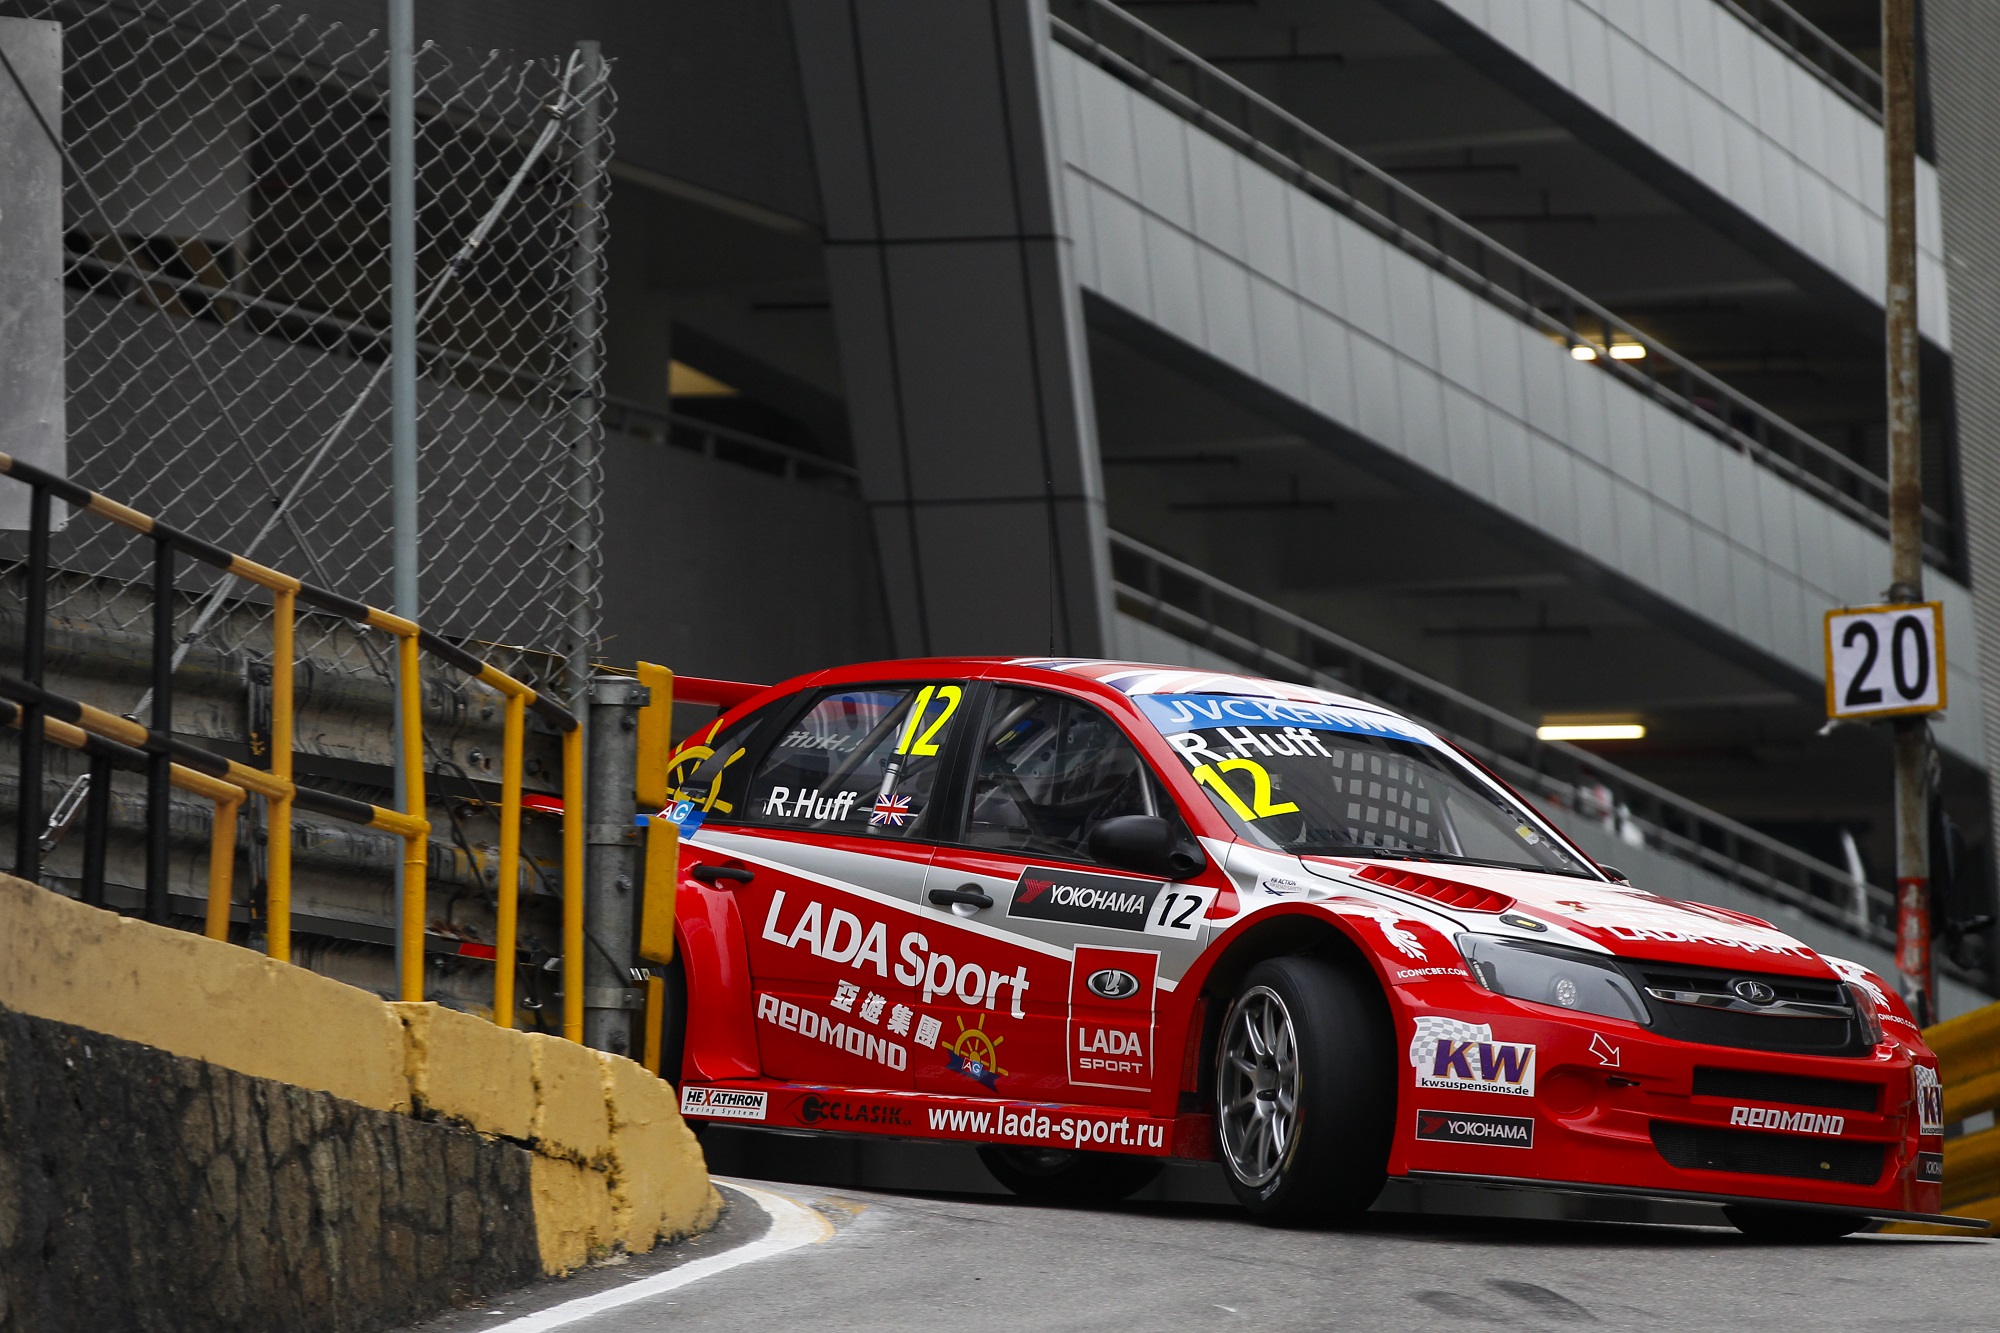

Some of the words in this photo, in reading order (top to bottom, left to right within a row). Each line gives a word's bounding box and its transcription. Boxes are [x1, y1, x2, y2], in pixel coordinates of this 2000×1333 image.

[1842, 614, 1929, 706] 20
[898, 685, 962, 756] 12
[1166, 726, 1332, 767] R.Huff
[766, 786, 857, 821] R.Huff
[1192, 758, 1300, 821] 12
[656, 803, 689, 820] AG
[1050, 885, 1145, 915] YOKOHAMA
[1158, 893, 1203, 929] 12
[1600, 923, 1716, 946] LADA
[762, 889, 888, 978] LADA
[894, 932, 1030, 1020] Sport
[1397, 967, 1469, 979] ICONICBET.COM
[830, 979, 942, 1050] 亞遊集團
[1079, 1028, 1143, 1057] LADA
[964, 1059, 981, 1074] AG
[1079, 1058, 1143, 1074] SPORT
[1433, 1039, 1534, 1085] KW
[686, 1090, 764, 1107] HEXATHRON
[1421, 1078, 1529, 1095] kwsuspensions.de
[684, 1105, 715, 1114] Racing
[722, 1108, 759, 1117] Systems
[928, 1106, 1163, 1148] www.lada-sport.ru
[1448, 1120, 1527, 1140] YOKOHAMA
